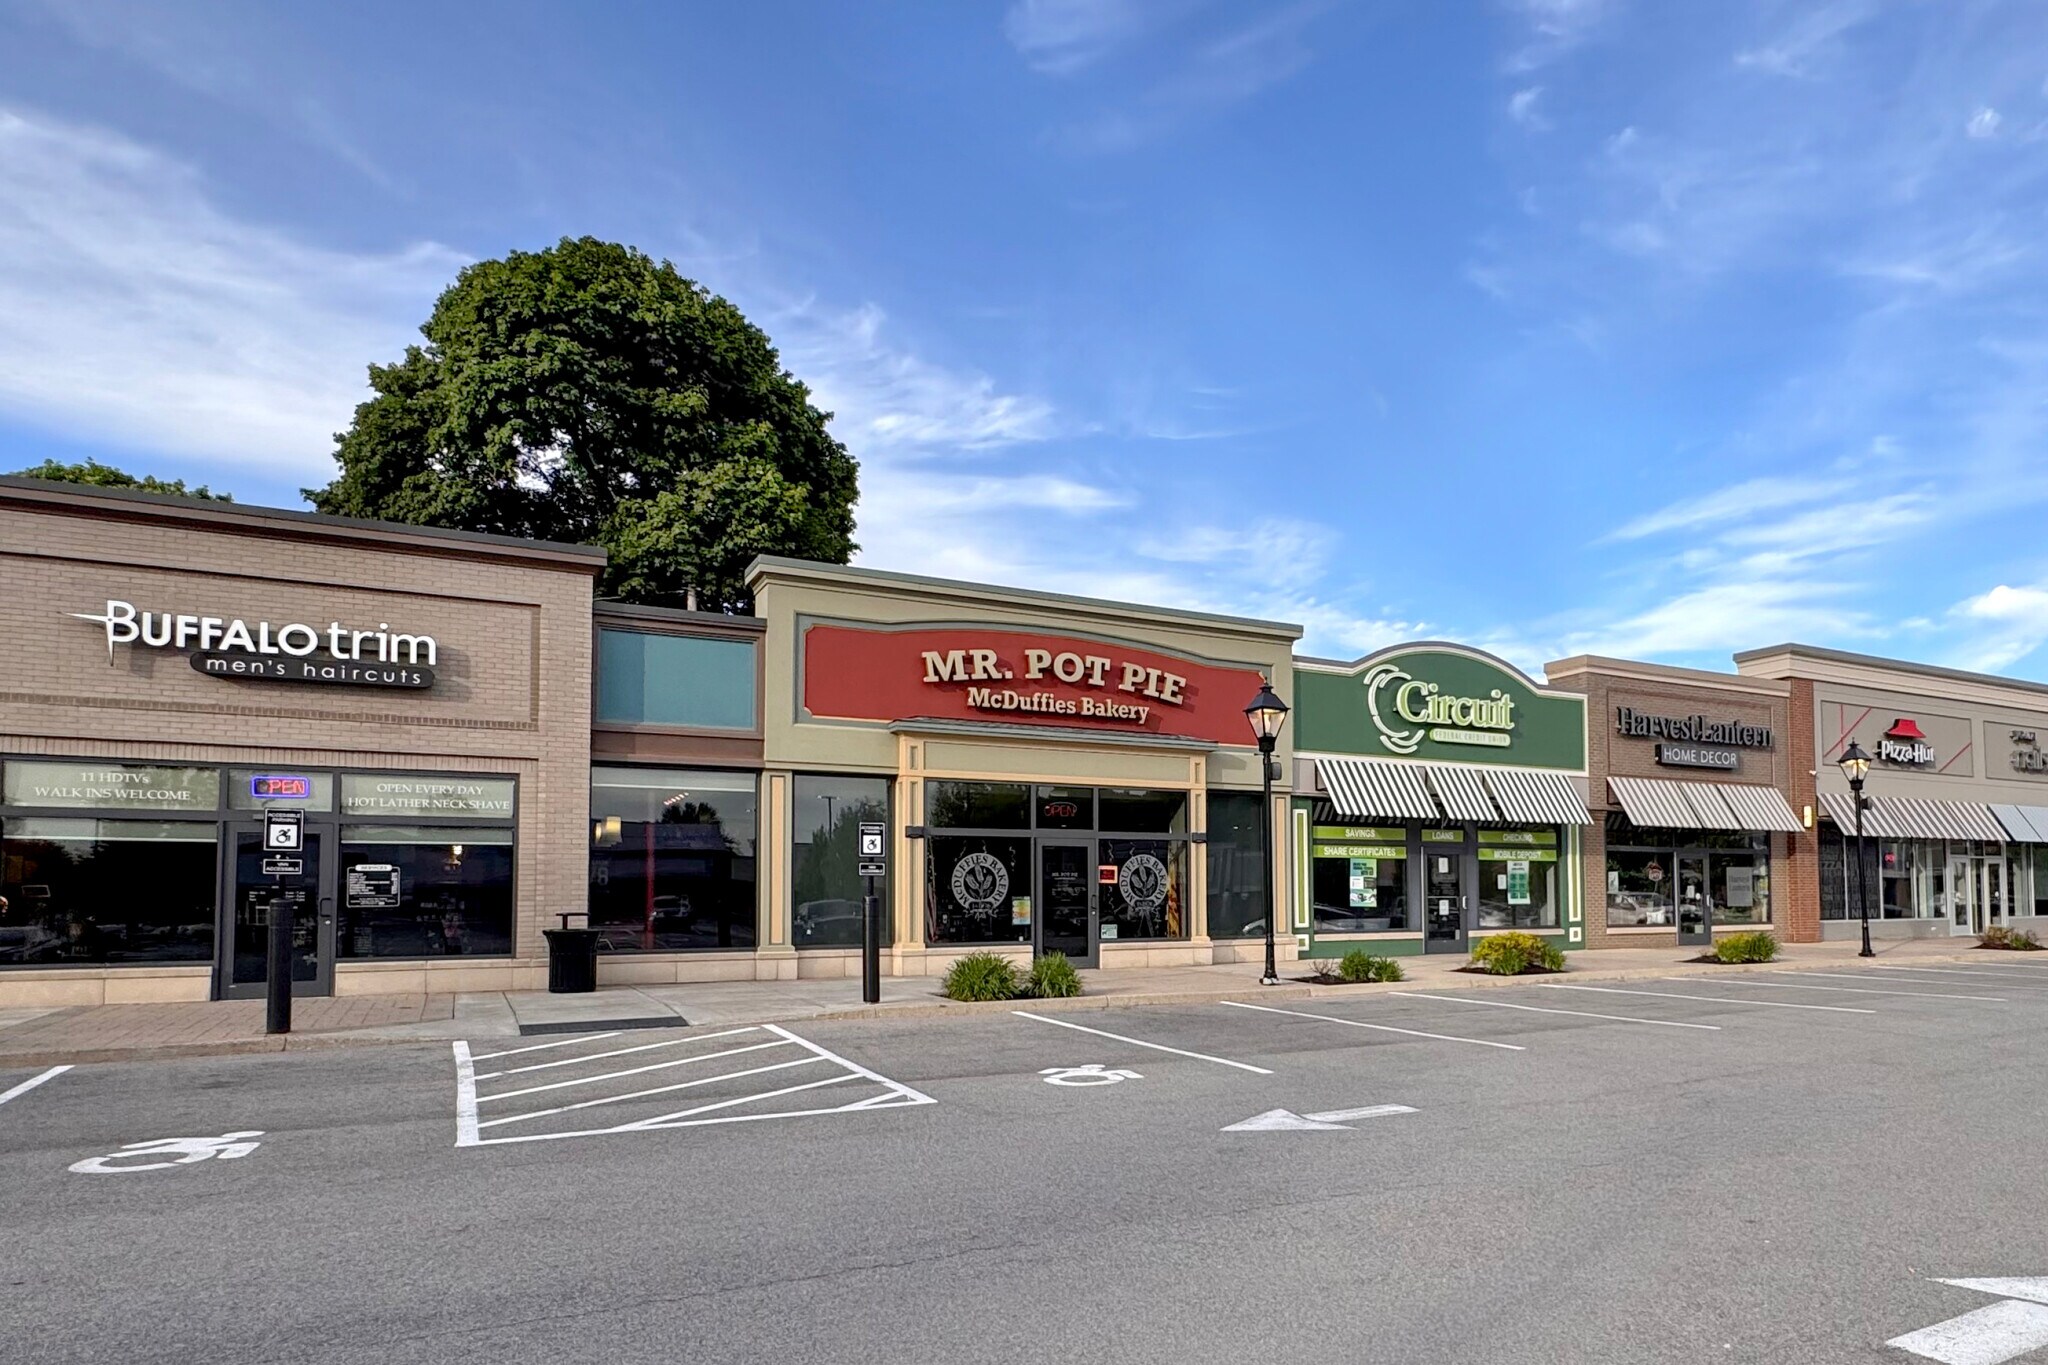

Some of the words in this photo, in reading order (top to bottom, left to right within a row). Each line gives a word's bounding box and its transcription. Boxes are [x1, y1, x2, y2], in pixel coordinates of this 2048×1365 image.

[107, 600, 318, 657] BUFFALO
[326, 622, 438, 666] trim
[206, 658, 286, 676] men's
[303, 662, 422, 685] haircuts
[921, 649, 1013, 683] MR.
[1024, 649, 1111, 687] POT
[1118, 662, 1187, 705] PIE
[967, 687, 1076, 715] McDuffies
[1080, 697, 1150, 725] Bakery
[1396, 680, 1515, 730] Circuit
[1617, 706, 1699, 742] Harvest
[1699, 714, 1774, 747] Lantern
[1663, 748, 1697, 763] HOME
[1700, 751, 1737, 765] DECOR
[1880, 741, 1913, 763] Pizza
[1914, 744, 1934, 763] Hut
[81, 772, 95, 782] 11
[99, 773, 150, 785] HDTVs
[34, 787, 82, 799] WALK
[85, 788, 112, 800] INS
[115, 788, 191, 801] WELCOME
[376, 783, 412, 793] OPEN
[415, 784, 457, 794] EVERY
[457, 786, 485, 795] DAY
[348, 797, 378, 807] HOT
[379, 798, 430, 808] LATHER
[431, 800, 469, 809] NECK
[468, 801, 511, 811] SHAVE
[1044, 804, 1076, 817] OPEN
[1345, 828, 1376, 839] SAVINGS
[1431, 831, 1454, 841] LOANS
[1323, 846, 1348, 856] SHARE
[1349, 847, 1396, 857] CERTIFICATES
